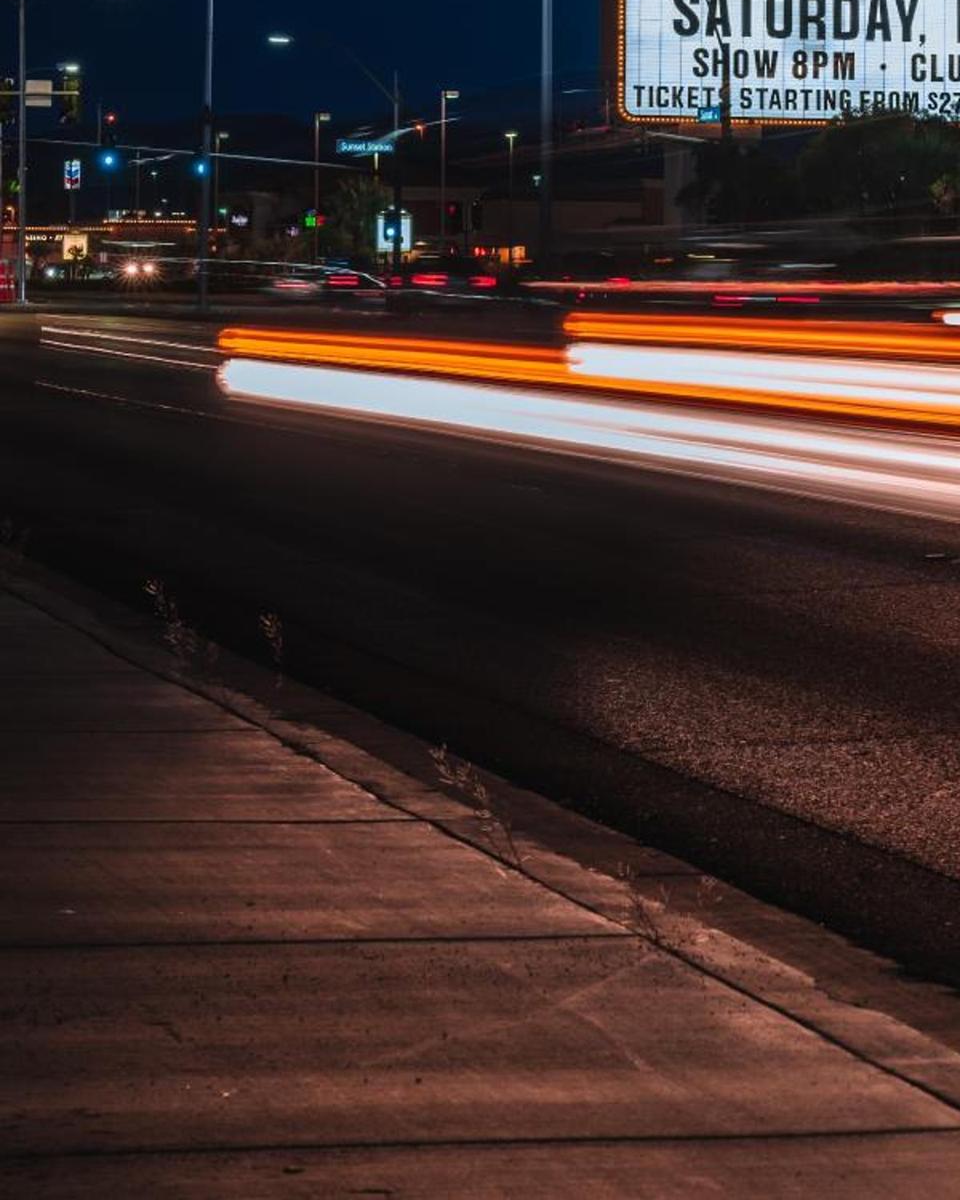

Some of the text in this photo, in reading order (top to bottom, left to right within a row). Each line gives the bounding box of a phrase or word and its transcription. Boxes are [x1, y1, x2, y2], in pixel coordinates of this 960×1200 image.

[692, 46, 779, 80] SHOW
[792, 49, 856, 81] 8PM
[739, 87, 852, 114] STARTING
[860, 90, 919, 114] FROM
